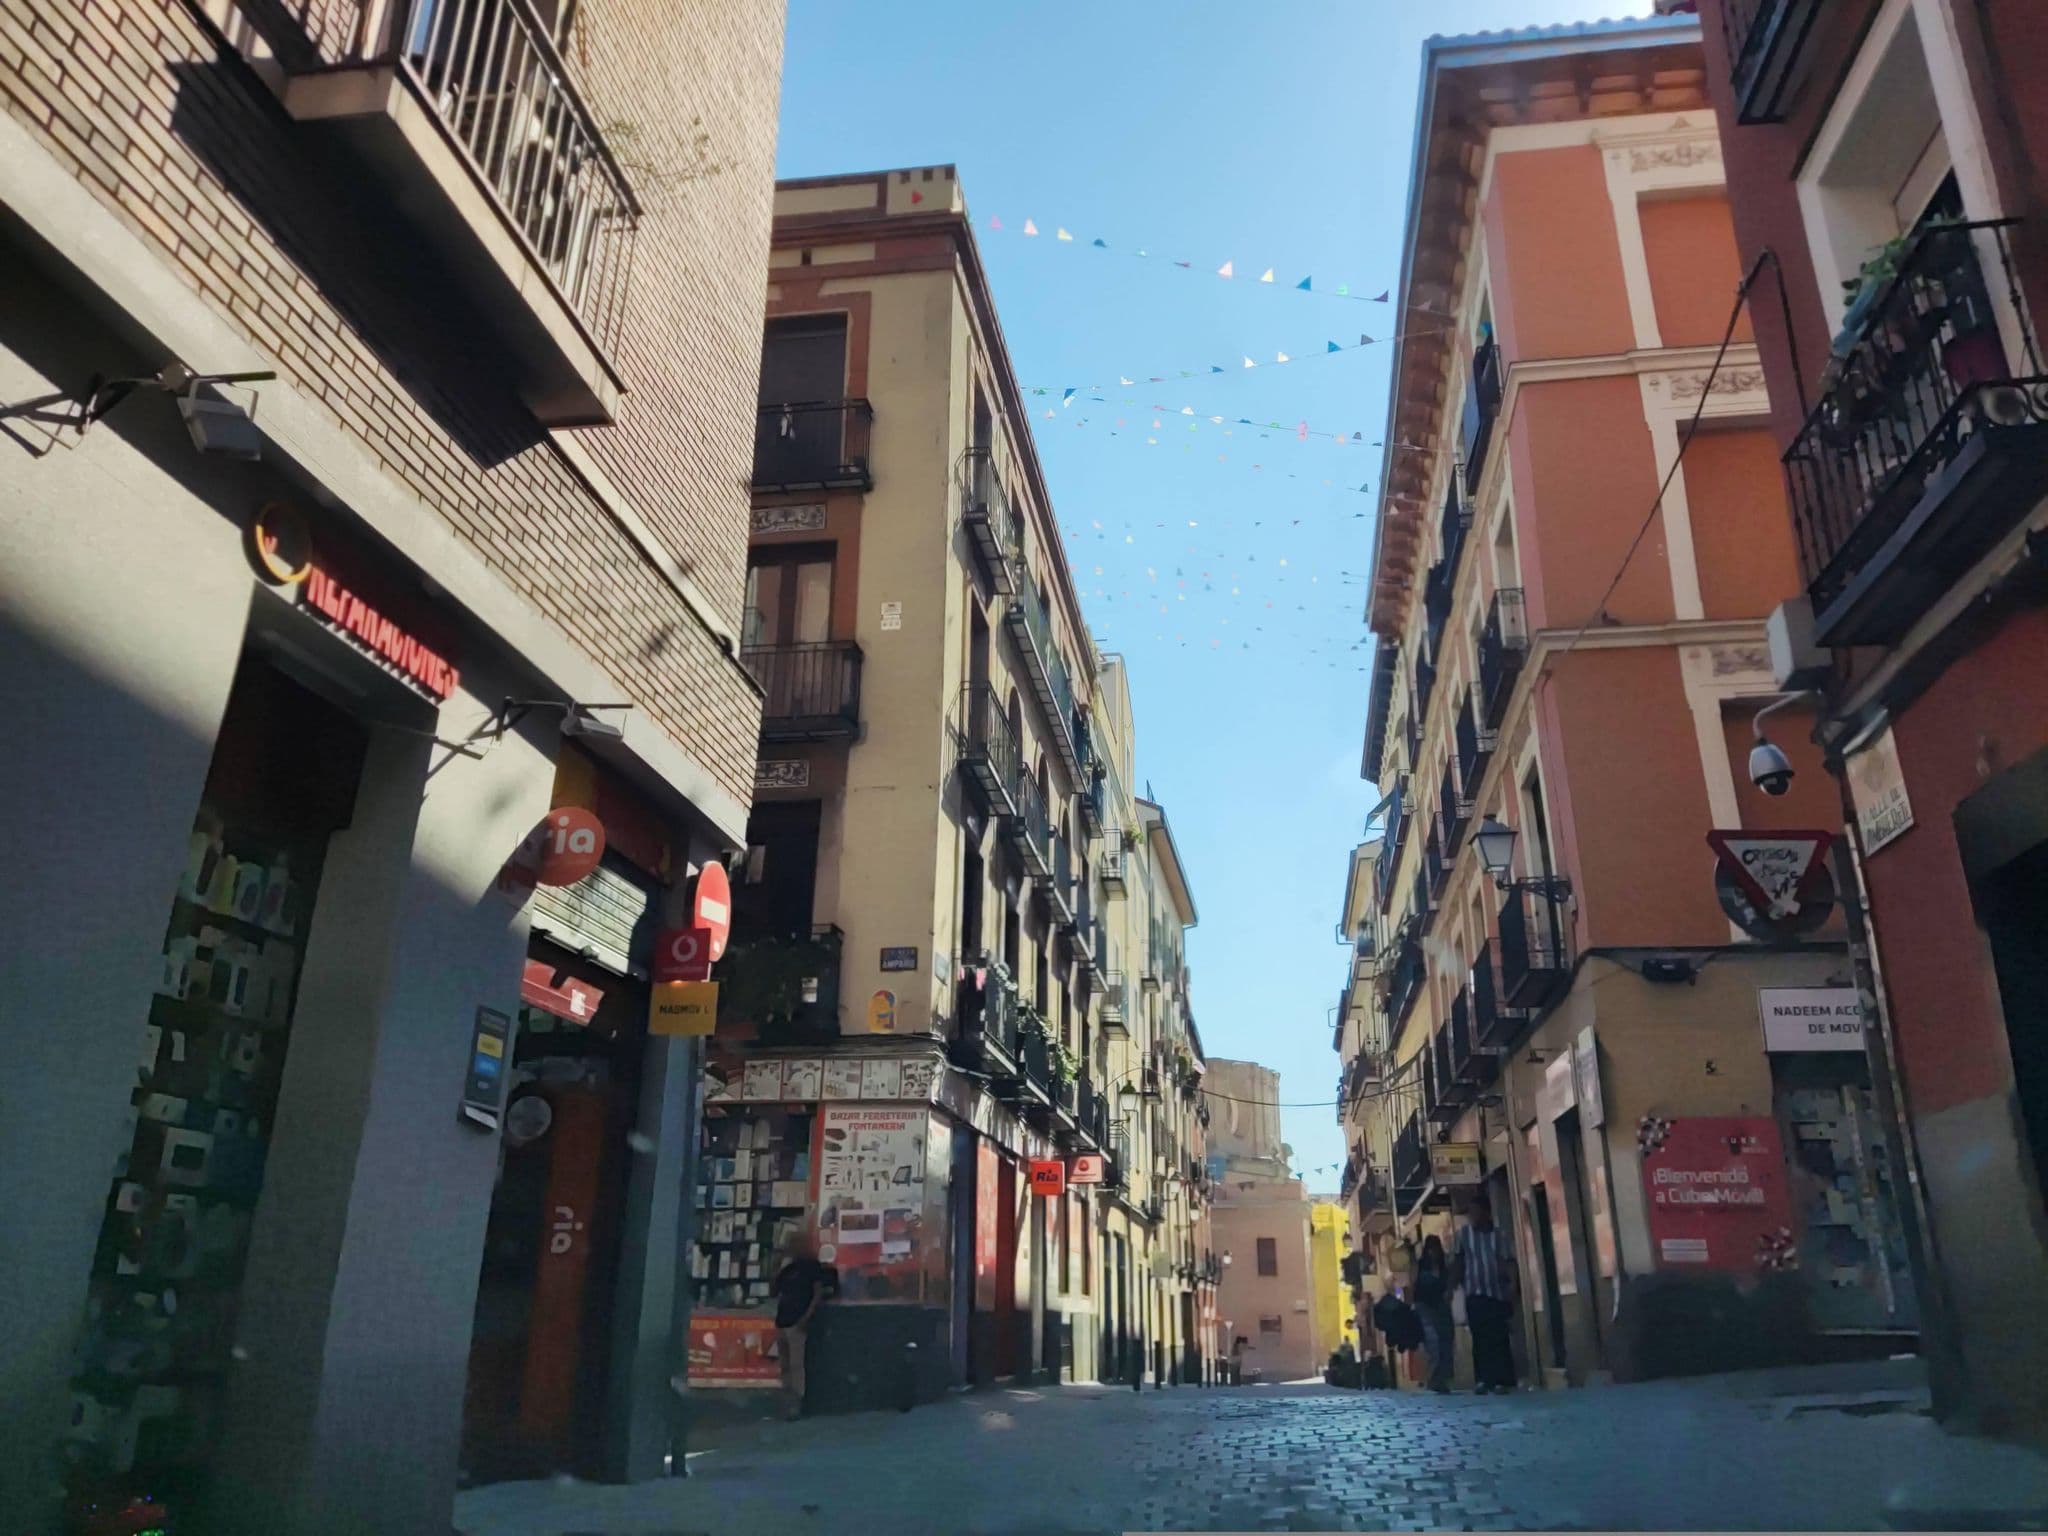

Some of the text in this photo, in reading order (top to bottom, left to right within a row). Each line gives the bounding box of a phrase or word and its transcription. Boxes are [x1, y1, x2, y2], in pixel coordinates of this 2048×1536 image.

[546, 815, 596, 855] ia
[1773, 1005, 1832, 1017] NADEEM
[1808, 1023, 1827, 1034] DE
[830, 1111, 861, 1121] BAZAR
[920, 1111, 925, 1121] Y
[1655, 1191, 1666, 1203] a
[550, 1205, 584, 1254] ria
